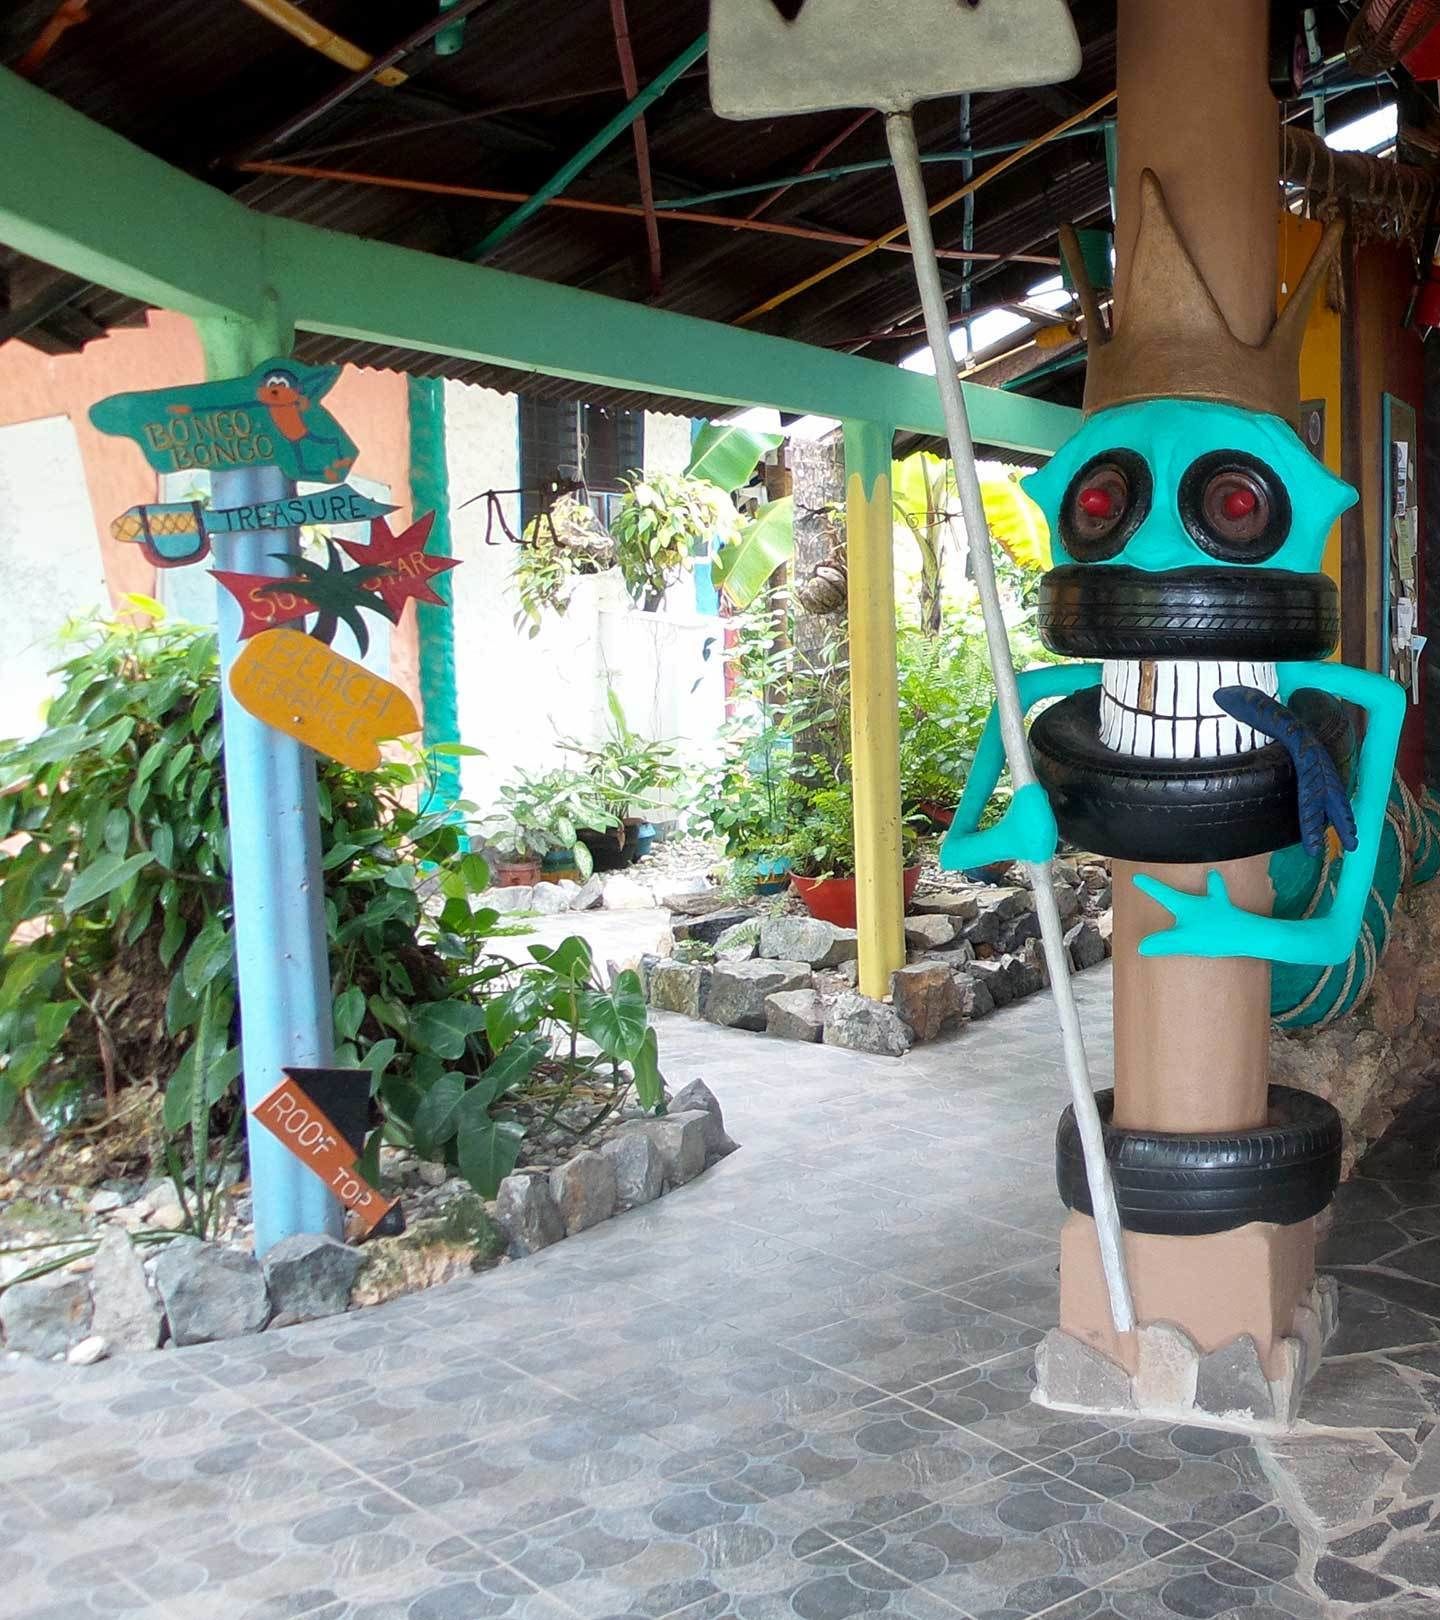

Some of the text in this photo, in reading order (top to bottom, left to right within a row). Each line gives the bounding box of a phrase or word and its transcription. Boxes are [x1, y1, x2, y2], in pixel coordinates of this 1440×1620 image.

[144, 409, 251, 451] BONGO
[171, 434, 274, 470] BONGO
[217, 494, 367, 532] TREASURE
[267, 632, 395, 719] BEACH
[267, 1092, 372, 1206] ROOF TOP
